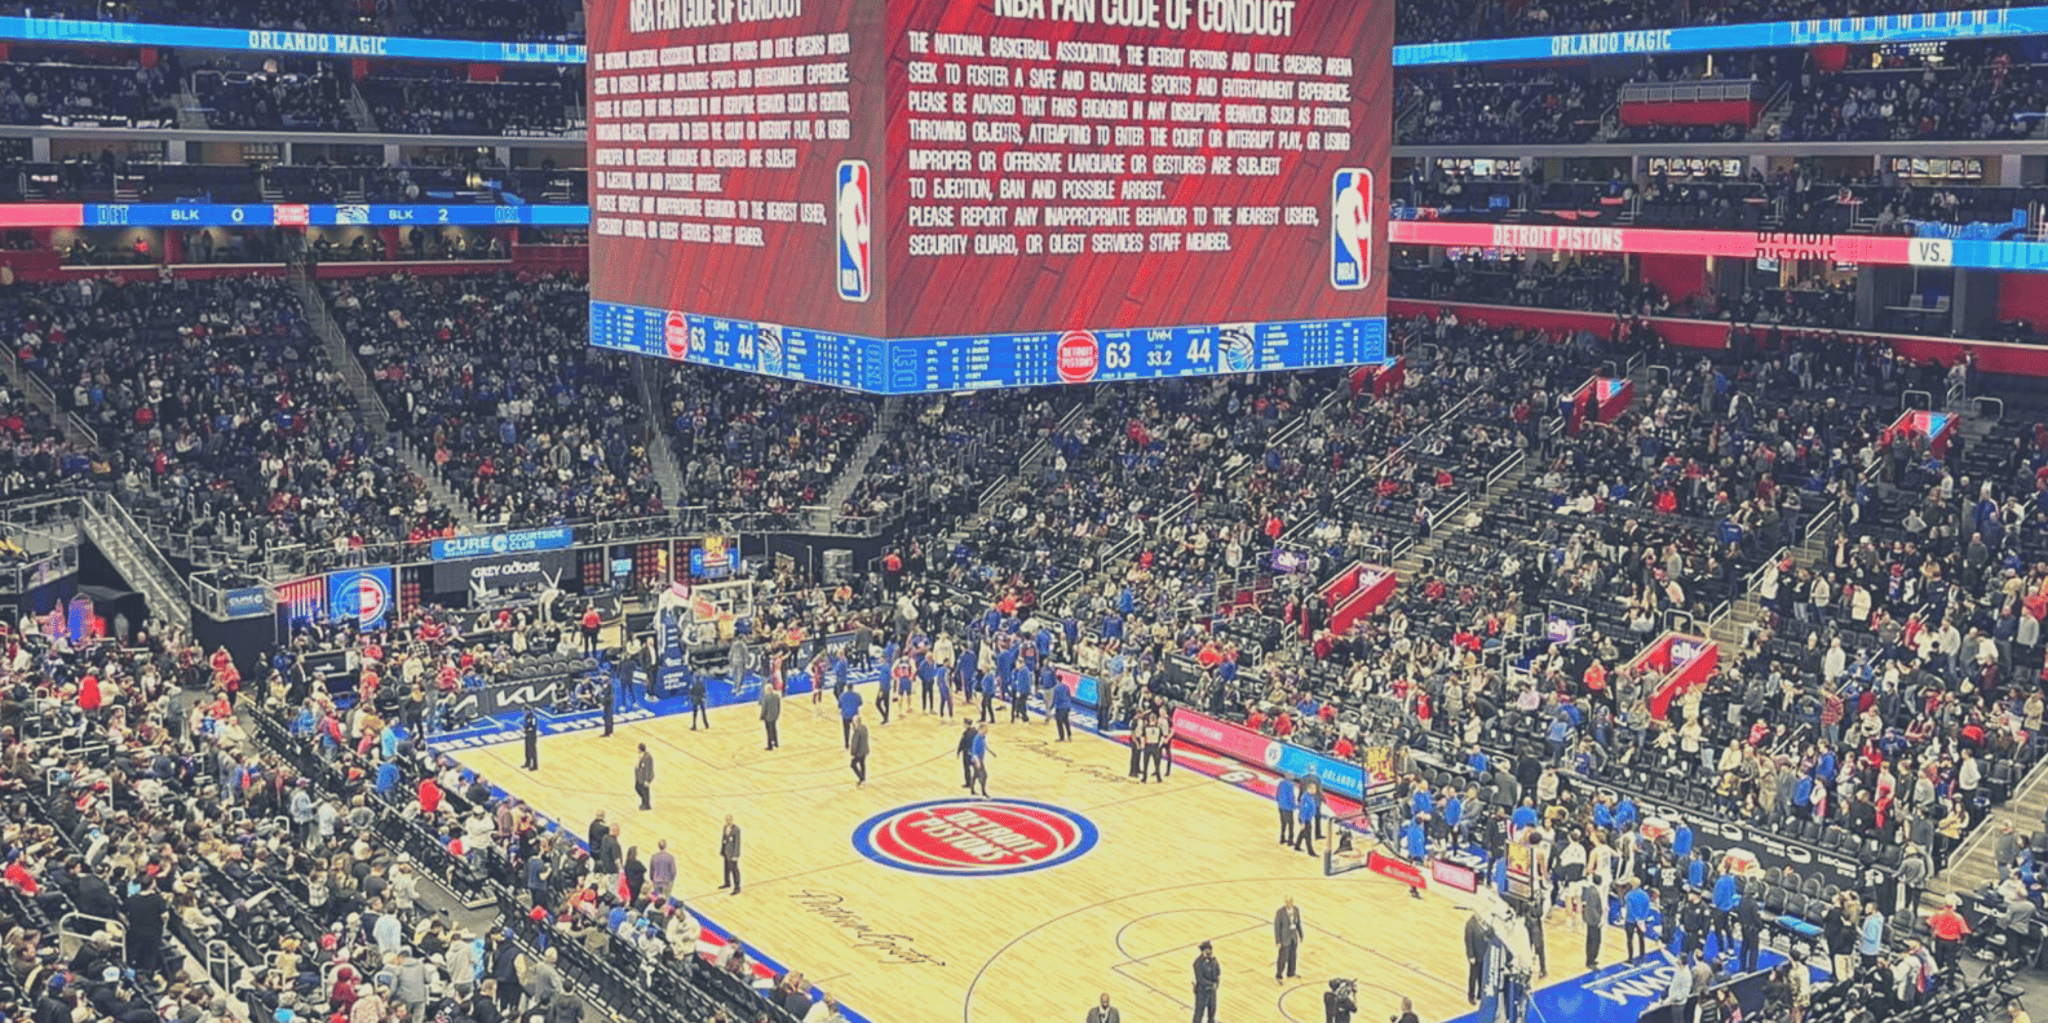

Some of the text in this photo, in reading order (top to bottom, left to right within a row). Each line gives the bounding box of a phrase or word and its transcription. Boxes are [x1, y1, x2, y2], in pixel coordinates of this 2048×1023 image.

[995, 0, 1295, 36] NBA FAN CODE OF CONDUCT
[249, 31, 387, 55] ORLANDO MAGIC
[908, 31, 928, 53] THE
[935, 33, 985, 56] NATIONAL
[990, 36, 1051, 60] BASKETBALL
[1056, 41, 1121, 66] ASSOCIATION,
[1126, 45, 1144, 66] THE
[1148, 47, 1185, 68] DETROIT
[1190, 50, 1228, 70] PISTONS
[1231, 52, 1251, 71] AND
[1254, 53, 1280, 73] LITTLE
[1283, 55, 1322, 75] CAESARS
[1551, 29, 1672, 56] ORLANDO MAGIC
[909, 61, 938, 83] SEEK
[944, 63, 961, 85] TO
[967, 65, 1009, 87] FOSTER
[1015, 67, 1024, 87] A
[1030, 68, 1056, 89] SAFE
[1062, 70, 1084, 90] AND
[1090, 71, 1146, 93] ENJOYABLE
[1151, 75, 1191, 95] SPORTS
[1196, 77, 1217, 96] AND
[1222, 78, 1294, 99] ENTERTAINMENT
[909, 91, 947, 112] PLEASE
[953, 93, 967, 114] BE
[1021, 95, 1046, 116] THAT
[1051, 97, 1077, 117] FANS
[1133, 101, 1143, 120] IN
[1147, 101, 1167, 120] ANY
[1171, 102, 1221, 122] DISRUPTIVE
[1225, 104, 1267, 124] BEHAVIOR
[1270, 106, 1294, 125] SUCH
[1298, 107, 1310, 125] AS
[909, 119, 966, 141] THROWING
[972, 121, 1023, 145] OBJECTS,
[1029, 123, 1091, 145] ATTEMPTING
[1096, 125, 1110, 146] TO
[1115, 126, 1144, 146] ENTER
[1150, 127, 1167, 147] THE
[1172, 128, 1204, 147] COURT
[1208, 129, 1222, 148] OR
[1227, 130, 1275, 149] INTERRUPT
[1279, 131, 1303, 151] PLAY,
[1307, 131, 1320, 150] OR
[909, 149, 1281, 175] IMPROPER OR OFFENSIVE LANGUAGE OR GESTURES ARE SUBJECT
[909, 178, 1166, 201] TO EJECTION, BAN AND POSSIBLE ARREST.
[171, 209, 199, 221] BLK
[389, 209, 414, 221] BLK
[438, 209, 449, 222] 2
[909, 206, 1319, 227] PLEASE REPORT ANY INAPPROPRIATE BEHAVIOR TO THE NEAREST USHER,
[909, 234, 968, 255] SECURITY
[974, 234, 1018, 256] GUARD,
[1026, 234, 1043, 254] OR
[1049, 234, 1087, 253] GUEST
[1092, 233, 1144, 253] SERVICES
[1149, 233, 1181, 252] STAFF
[1493, 224, 1623, 249] DETROIT PISTONS
[1919, 242, 1946, 262] VS.
[690, 327, 706, 352] 63
[737, 334, 753, 360] 44
[1187, 338, 1211, 363] 44
[1106, 342, 1131, 368] 63
[1147, 351, 1173, 366] 33.2
[443, 536, 491, 552] CURE
[908, 816, 1014, 861] PISTONS
[943, 810, 1047, 852] DETROIT
